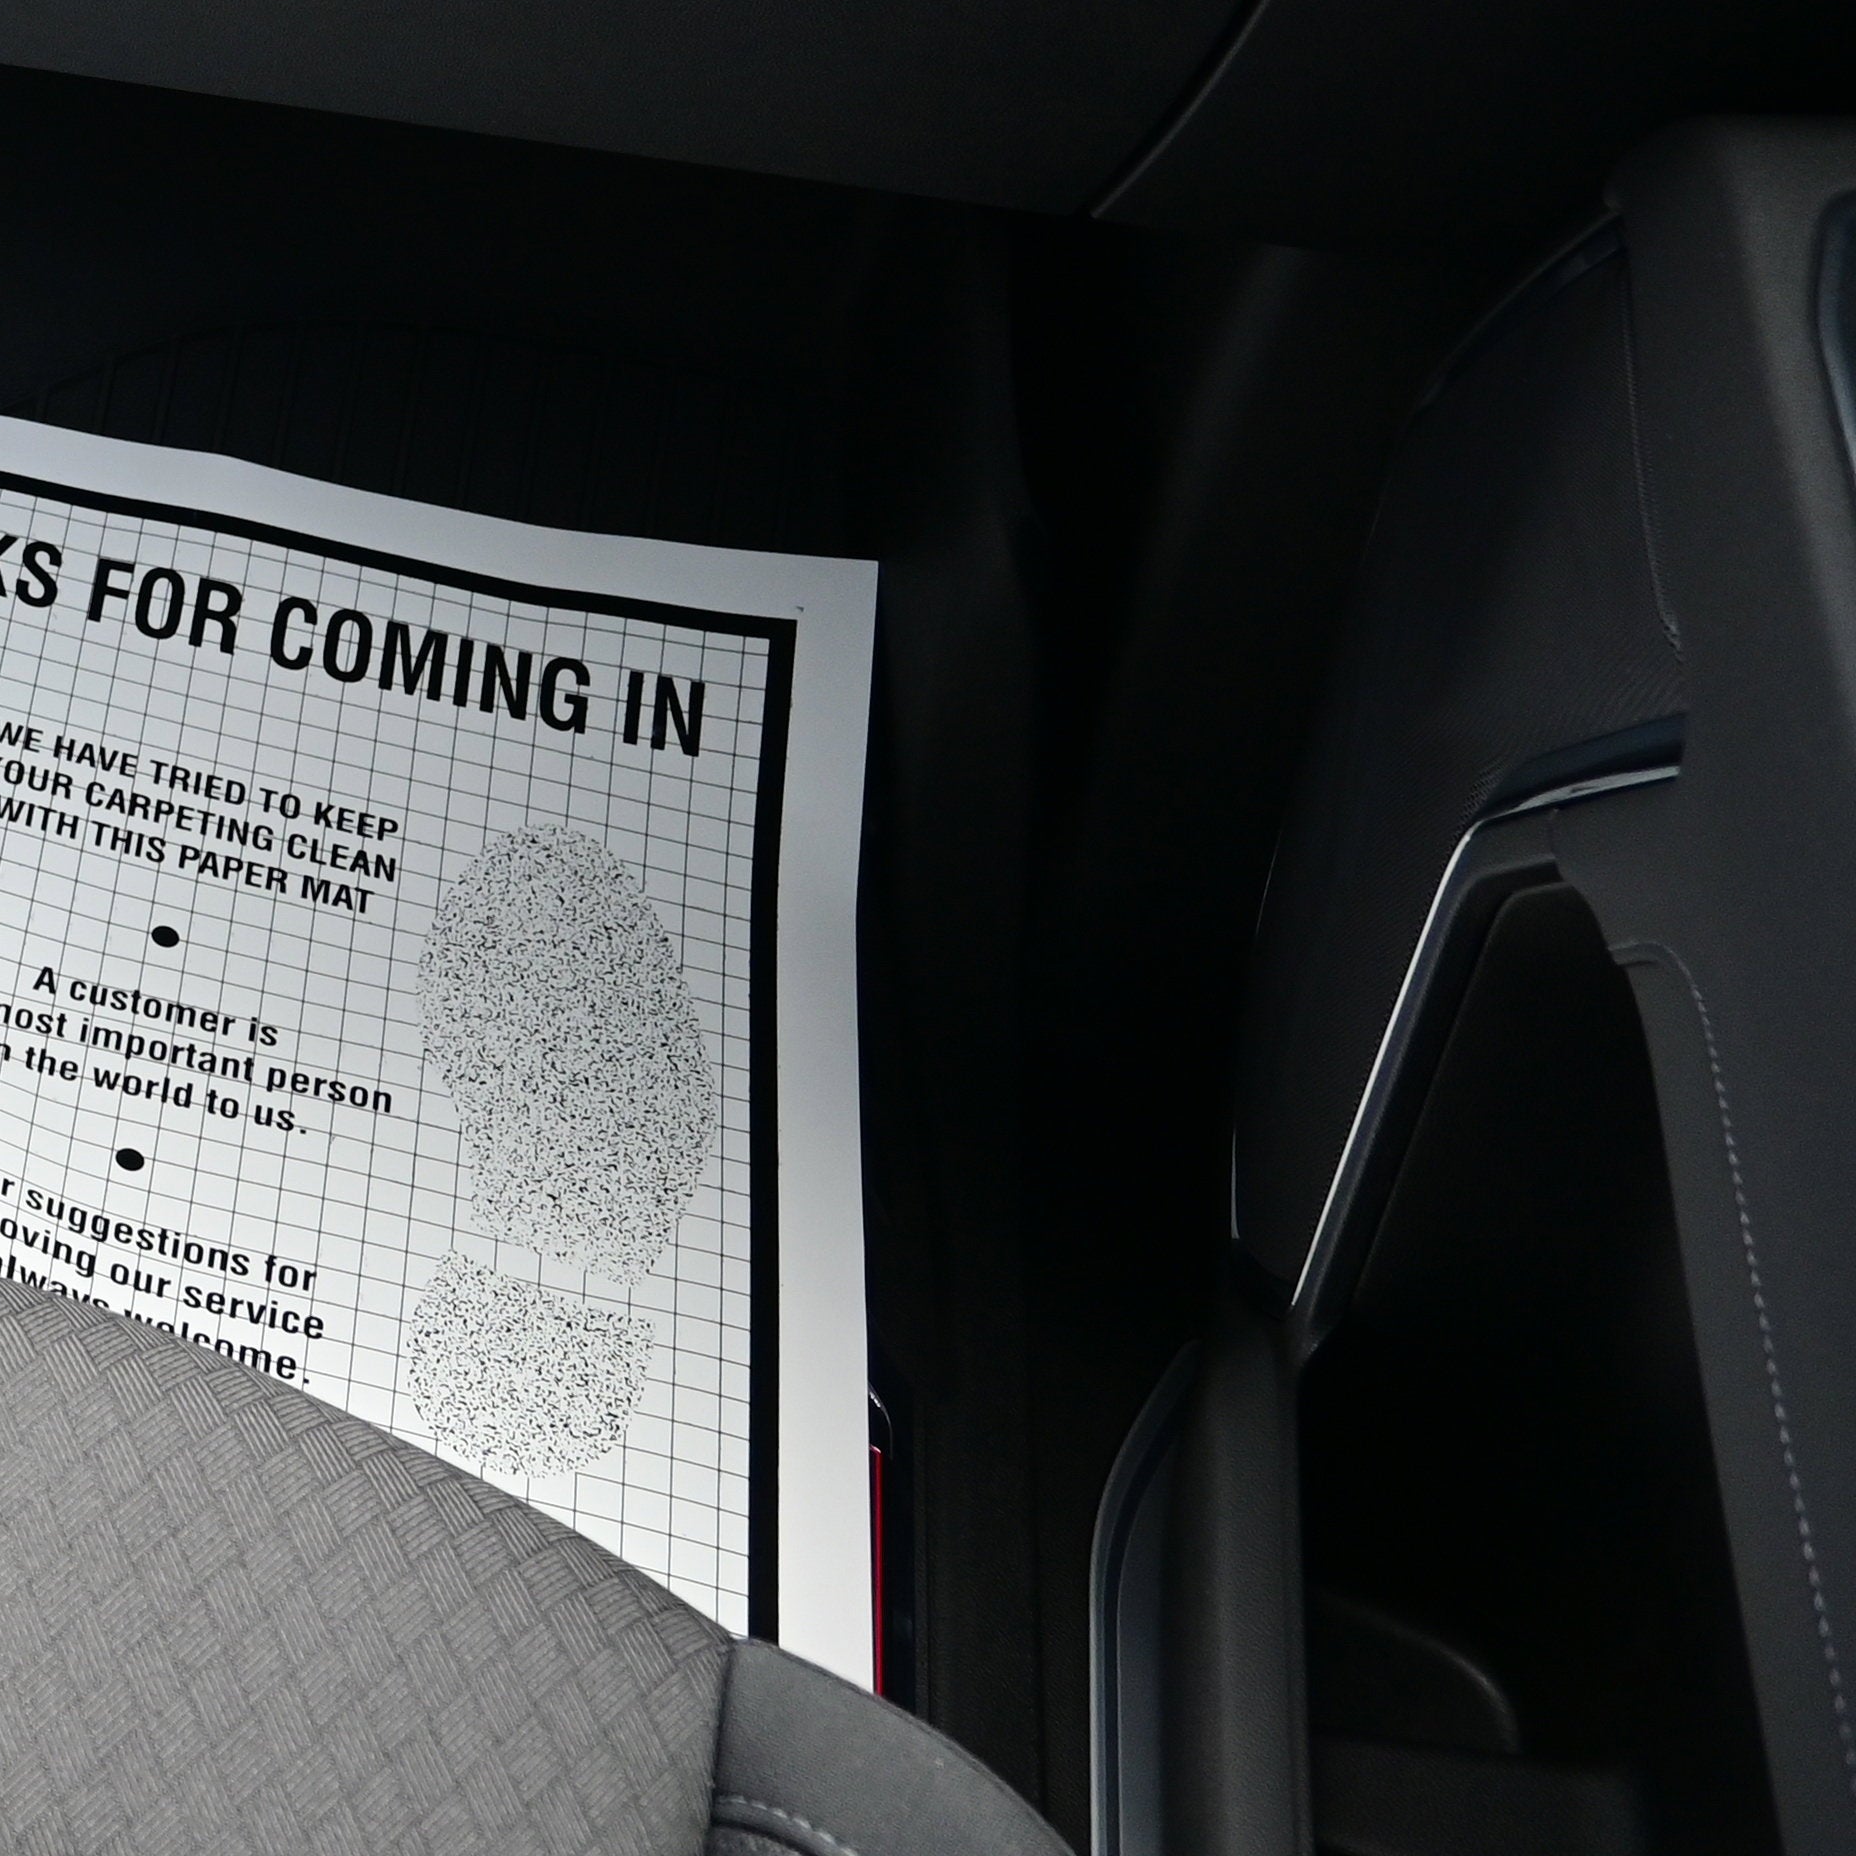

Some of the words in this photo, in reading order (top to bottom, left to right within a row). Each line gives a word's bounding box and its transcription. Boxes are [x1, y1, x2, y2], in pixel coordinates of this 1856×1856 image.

[87, 557, 241, 655] FOR
[270, 596, 592, 734] COMING
[622, 671, 705, 757] IN
[53, 735, 139, 778] HAVE
[150, 759, 247, 805] TRIED
[259, 788, 302, 819] TO
[313, 801, 399, 841] KEEP
[85, 782, 274, 851] CARPETING
[287, 834, 397, 882] CLEAN
[93, 821, 167, 863] THIS
[179, 845, 287, 893] PAPER
[300, 875, 375, 914] MAT
[33, 966, 57, 995] A
[69, 979, 237, 1036] customer
[249, 1016, 279, 1046] is
[25, 1045, 79, 1082] the
[92, 1067, 193, 1107] world
[206, 1088, 239, 1119] to
[254, 1104, 308, 1134] us.
[79, 1019, 255, 1083] important
[267, 1064, 394, 1113] person
[26, 1186, 250, 1277] suggestions
[265, 1255, 318, 1292] for
[110, 1262, 171, 1299] our
[184, 1284, 325, 1339] service
